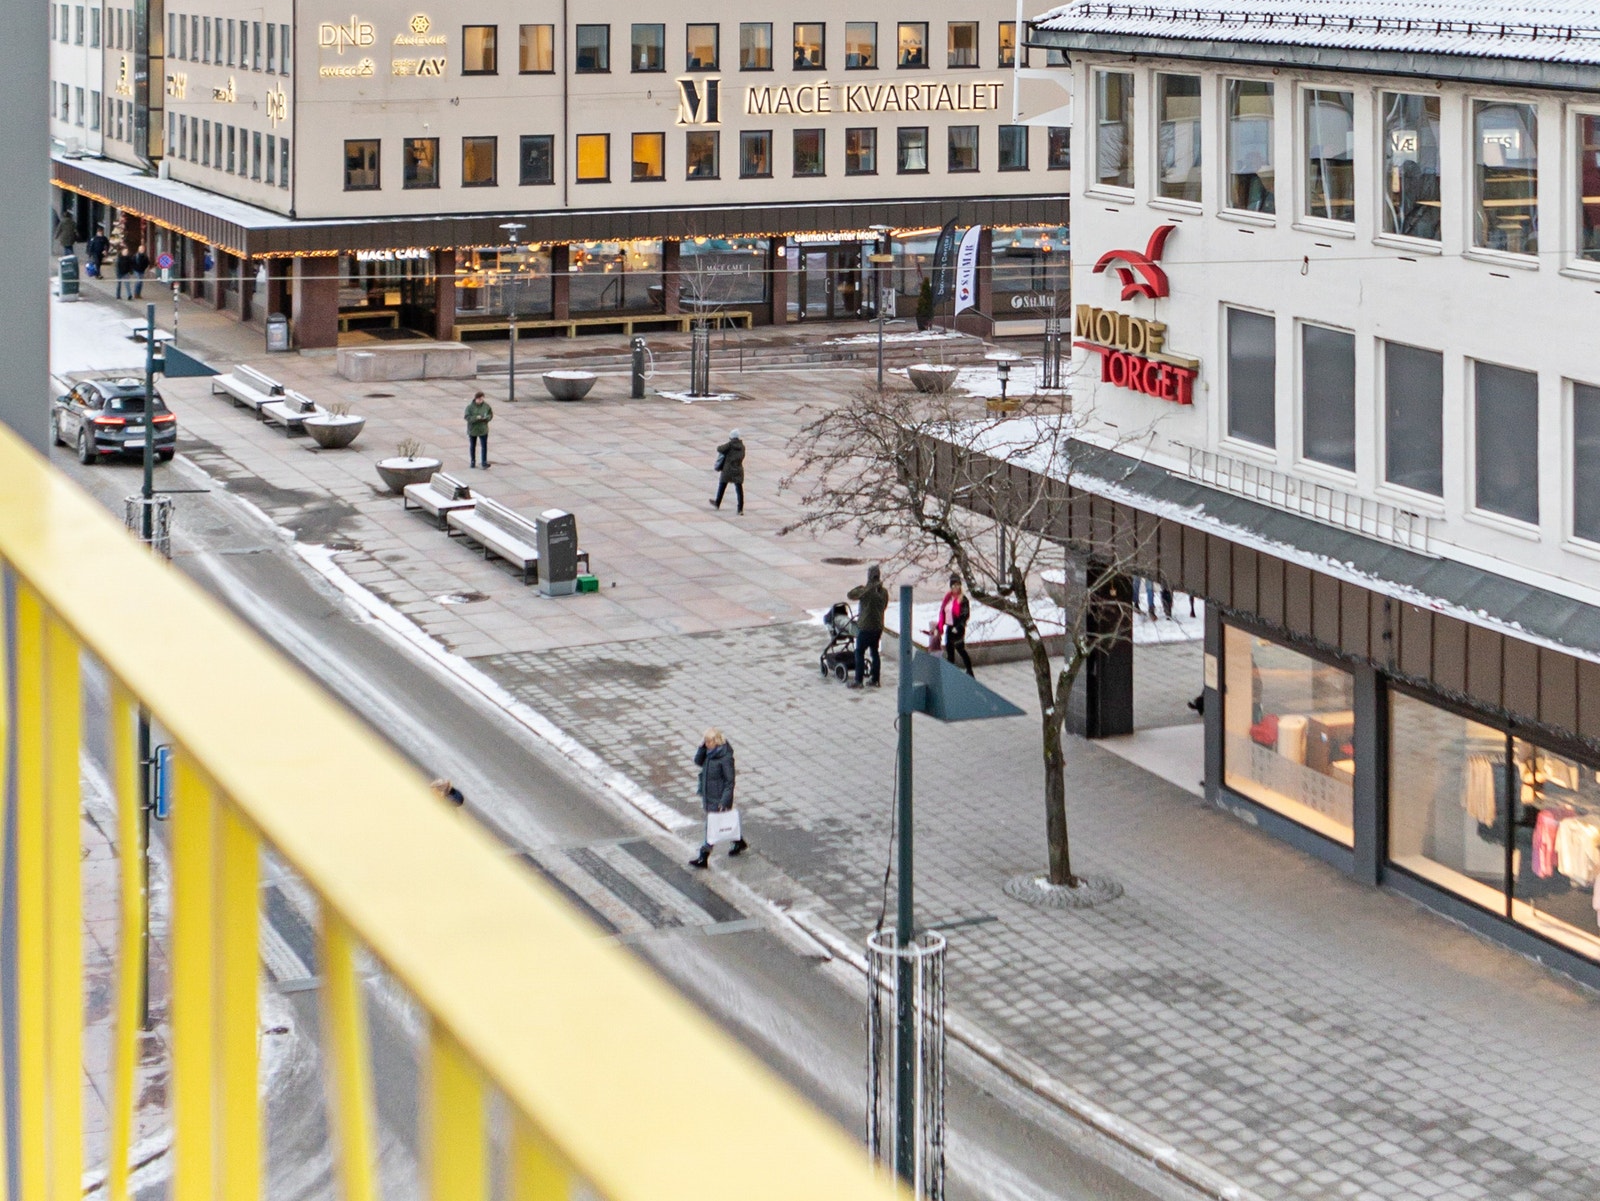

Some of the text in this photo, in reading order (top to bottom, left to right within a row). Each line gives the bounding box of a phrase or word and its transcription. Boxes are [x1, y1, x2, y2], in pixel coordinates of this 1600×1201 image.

[320, 16, 375, 54] DNB
[320, 66, 358, 77] SWECO
[265, 81, 286, 129] DNB
[747, 81, 1004, 114] MACÉ KVARTALET
[777, 246, 786, 257] 8
[857, 231, 881, 240] Mold
[1074, 304, 1198, 368] MOLDE
[1073, 341, 1197, 405] TORGET
